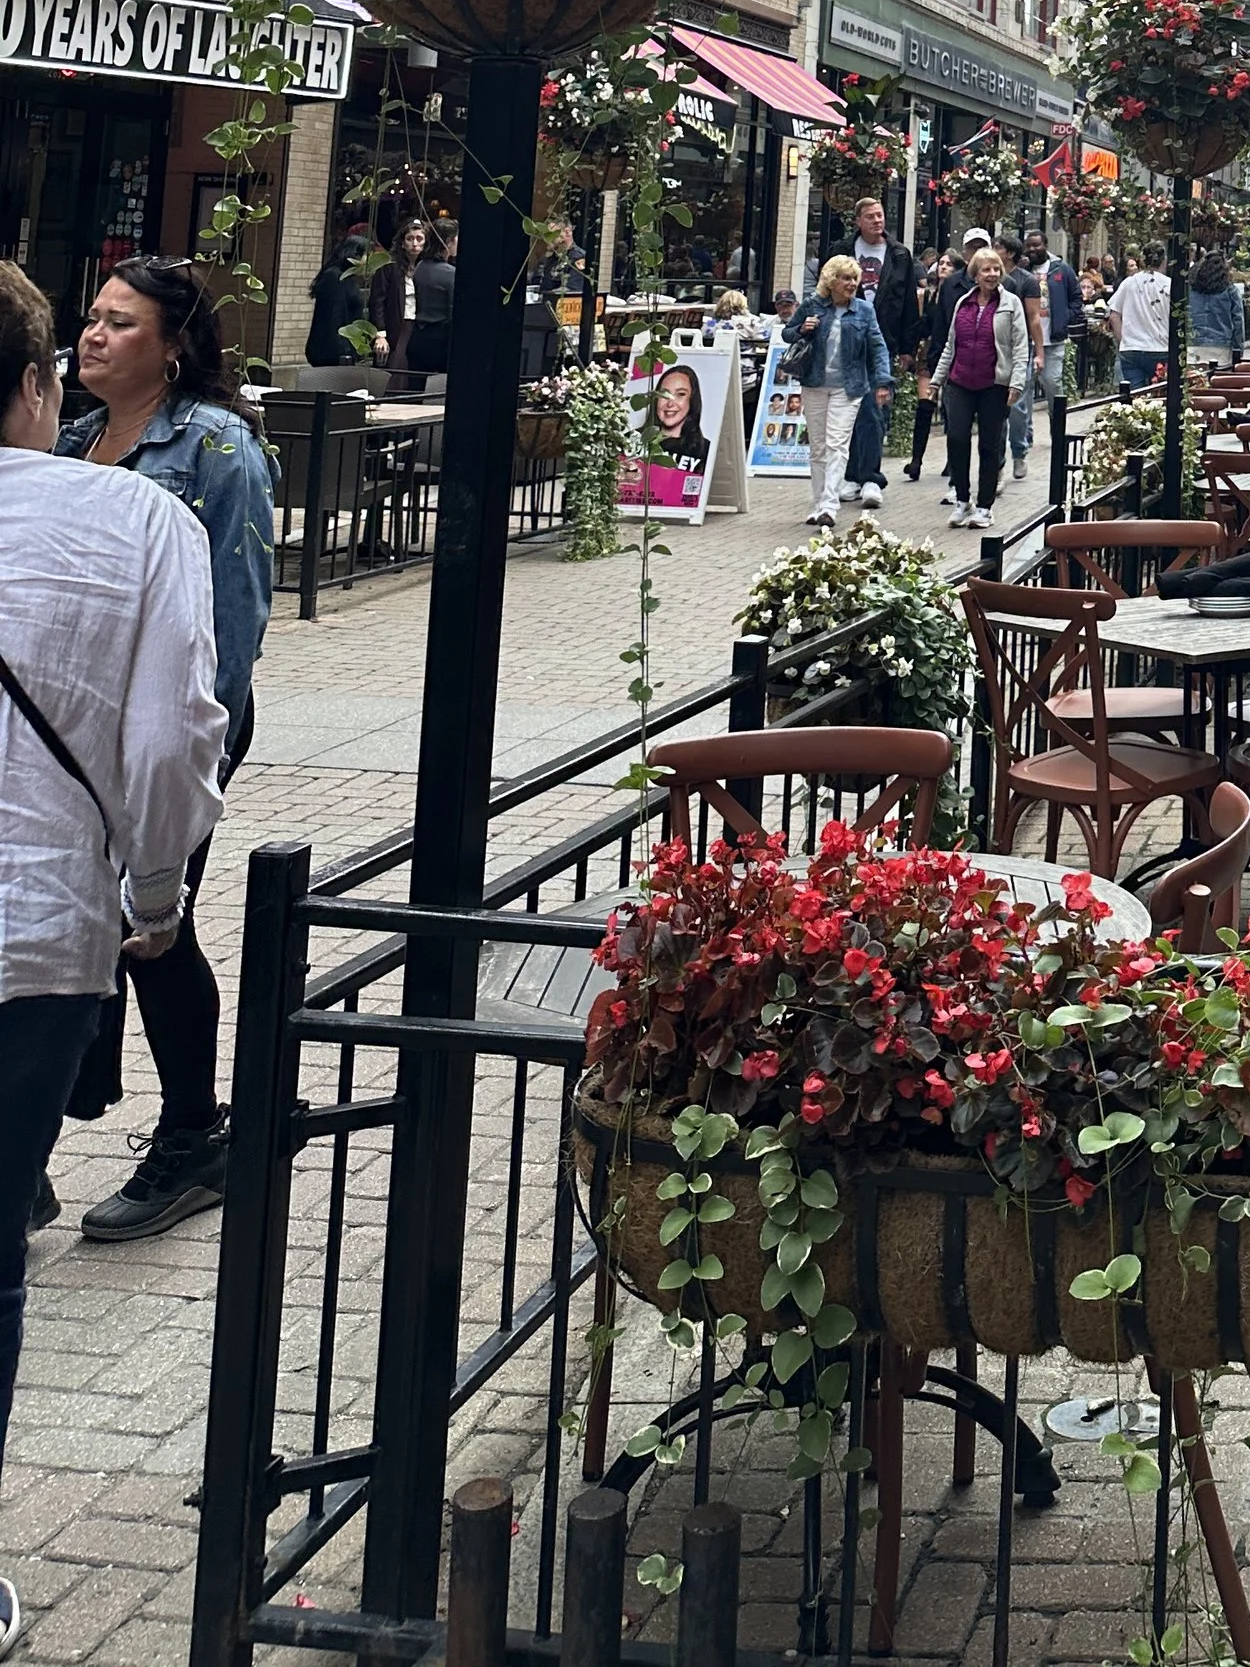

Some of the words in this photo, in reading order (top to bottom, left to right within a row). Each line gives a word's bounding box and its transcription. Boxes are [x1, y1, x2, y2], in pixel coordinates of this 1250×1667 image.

[141, 2, 187, 72] OF
[841, 19, 880, 45] OLD-WORLD
[909, 38, 979, 86] BUTCHER
[988, 69, 1036, 109] BREWER
[1052, 125, 1074, 134] FDC
